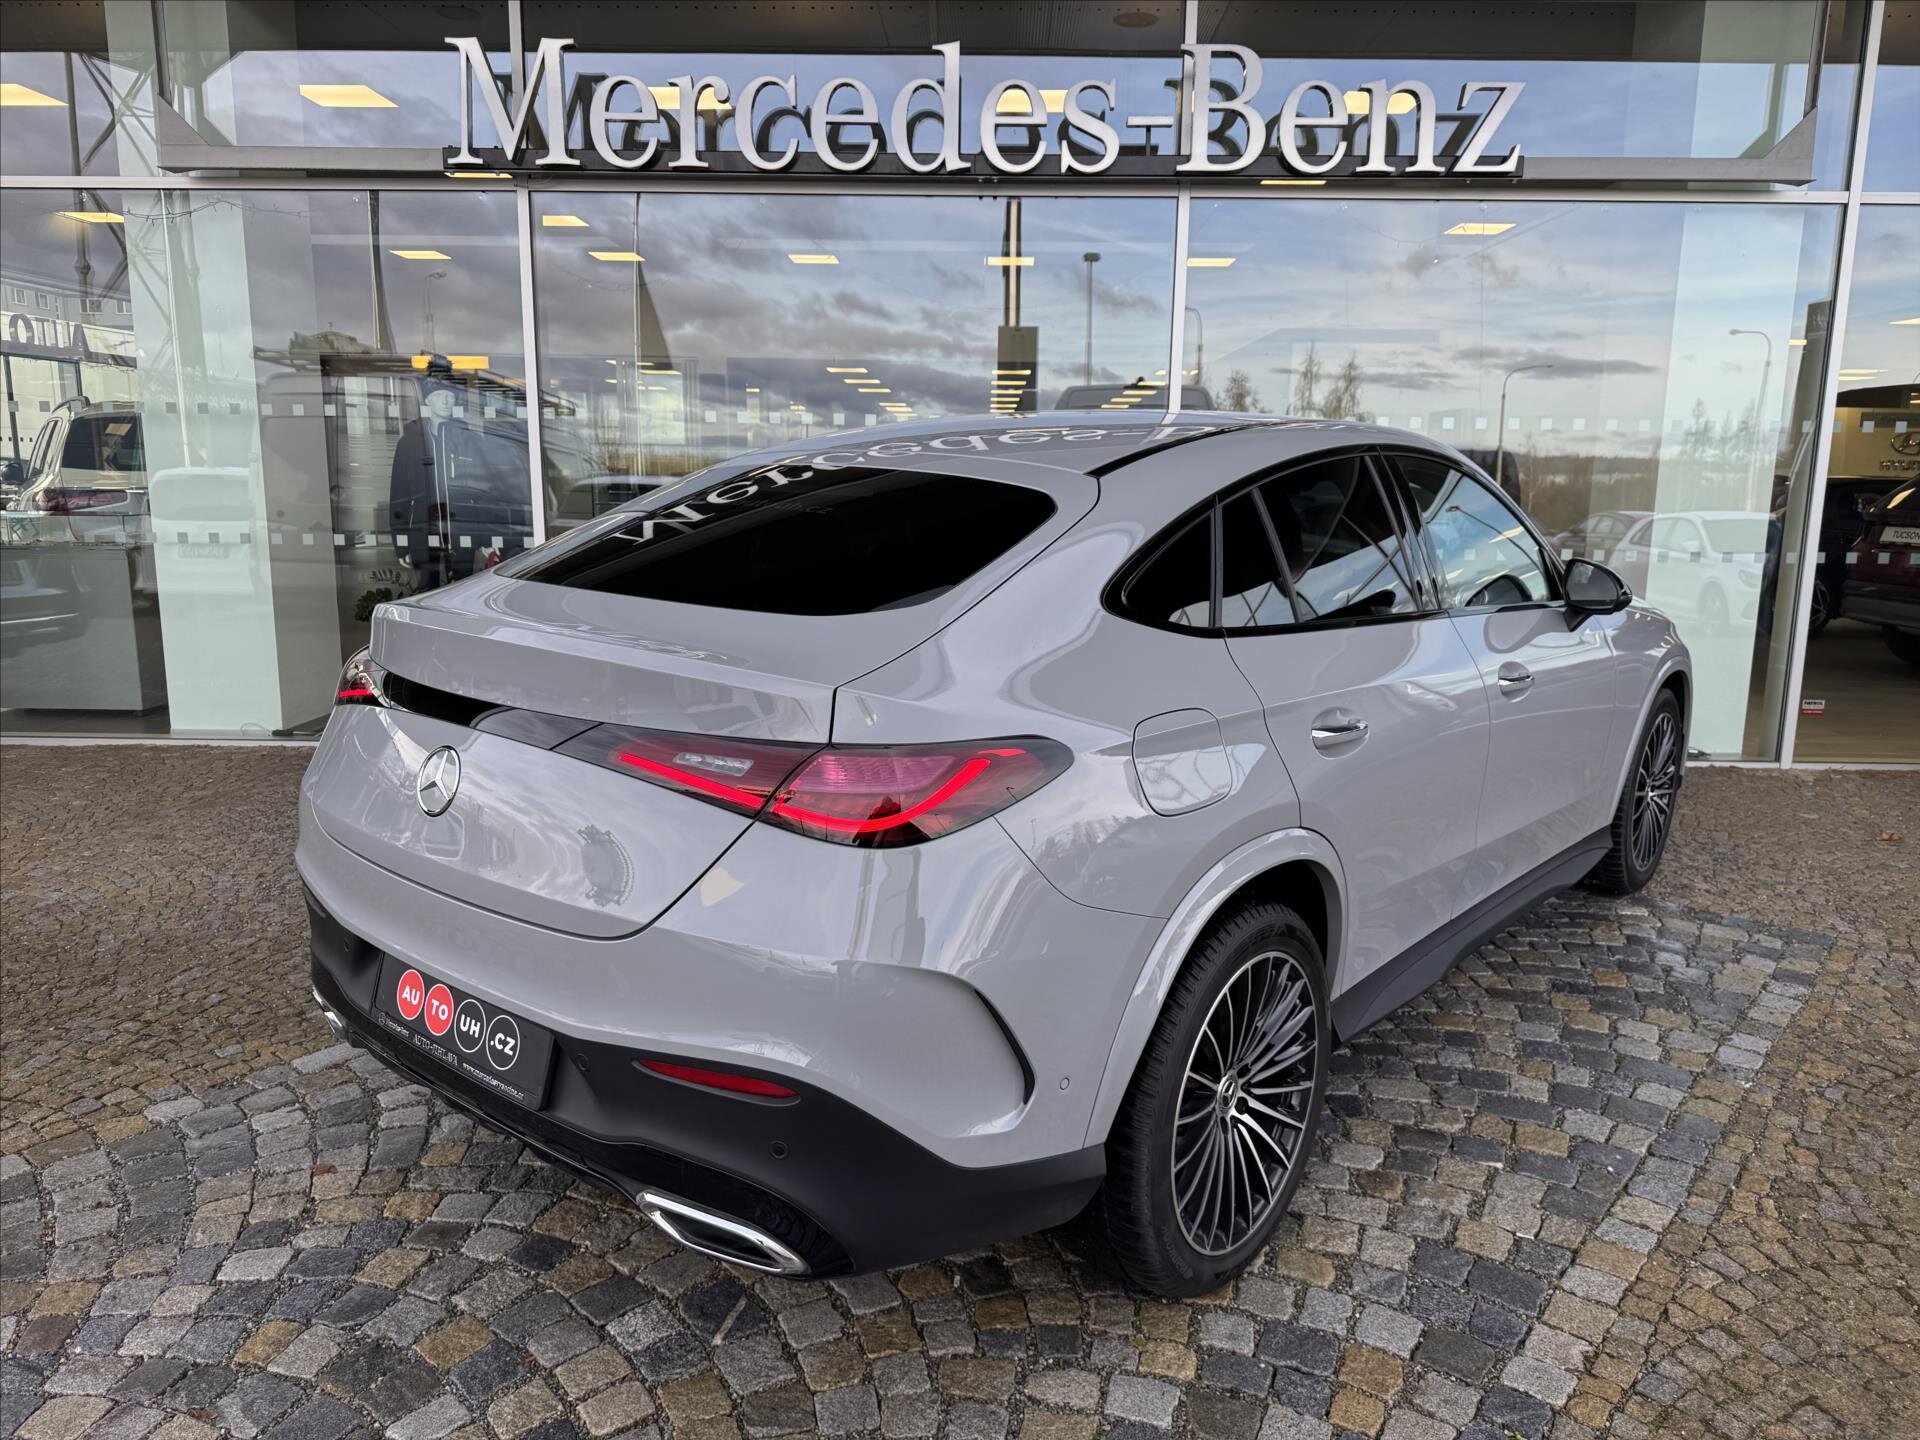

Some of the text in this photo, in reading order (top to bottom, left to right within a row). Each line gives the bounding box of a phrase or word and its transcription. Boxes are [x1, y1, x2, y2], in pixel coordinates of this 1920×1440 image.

[444, 36, 1527, 175] Mercedes-Benz
[402, 986, 420, 1005] AU
[431, 999, 448, 1020] TO
[460, 1015, 481, 1038] UH
